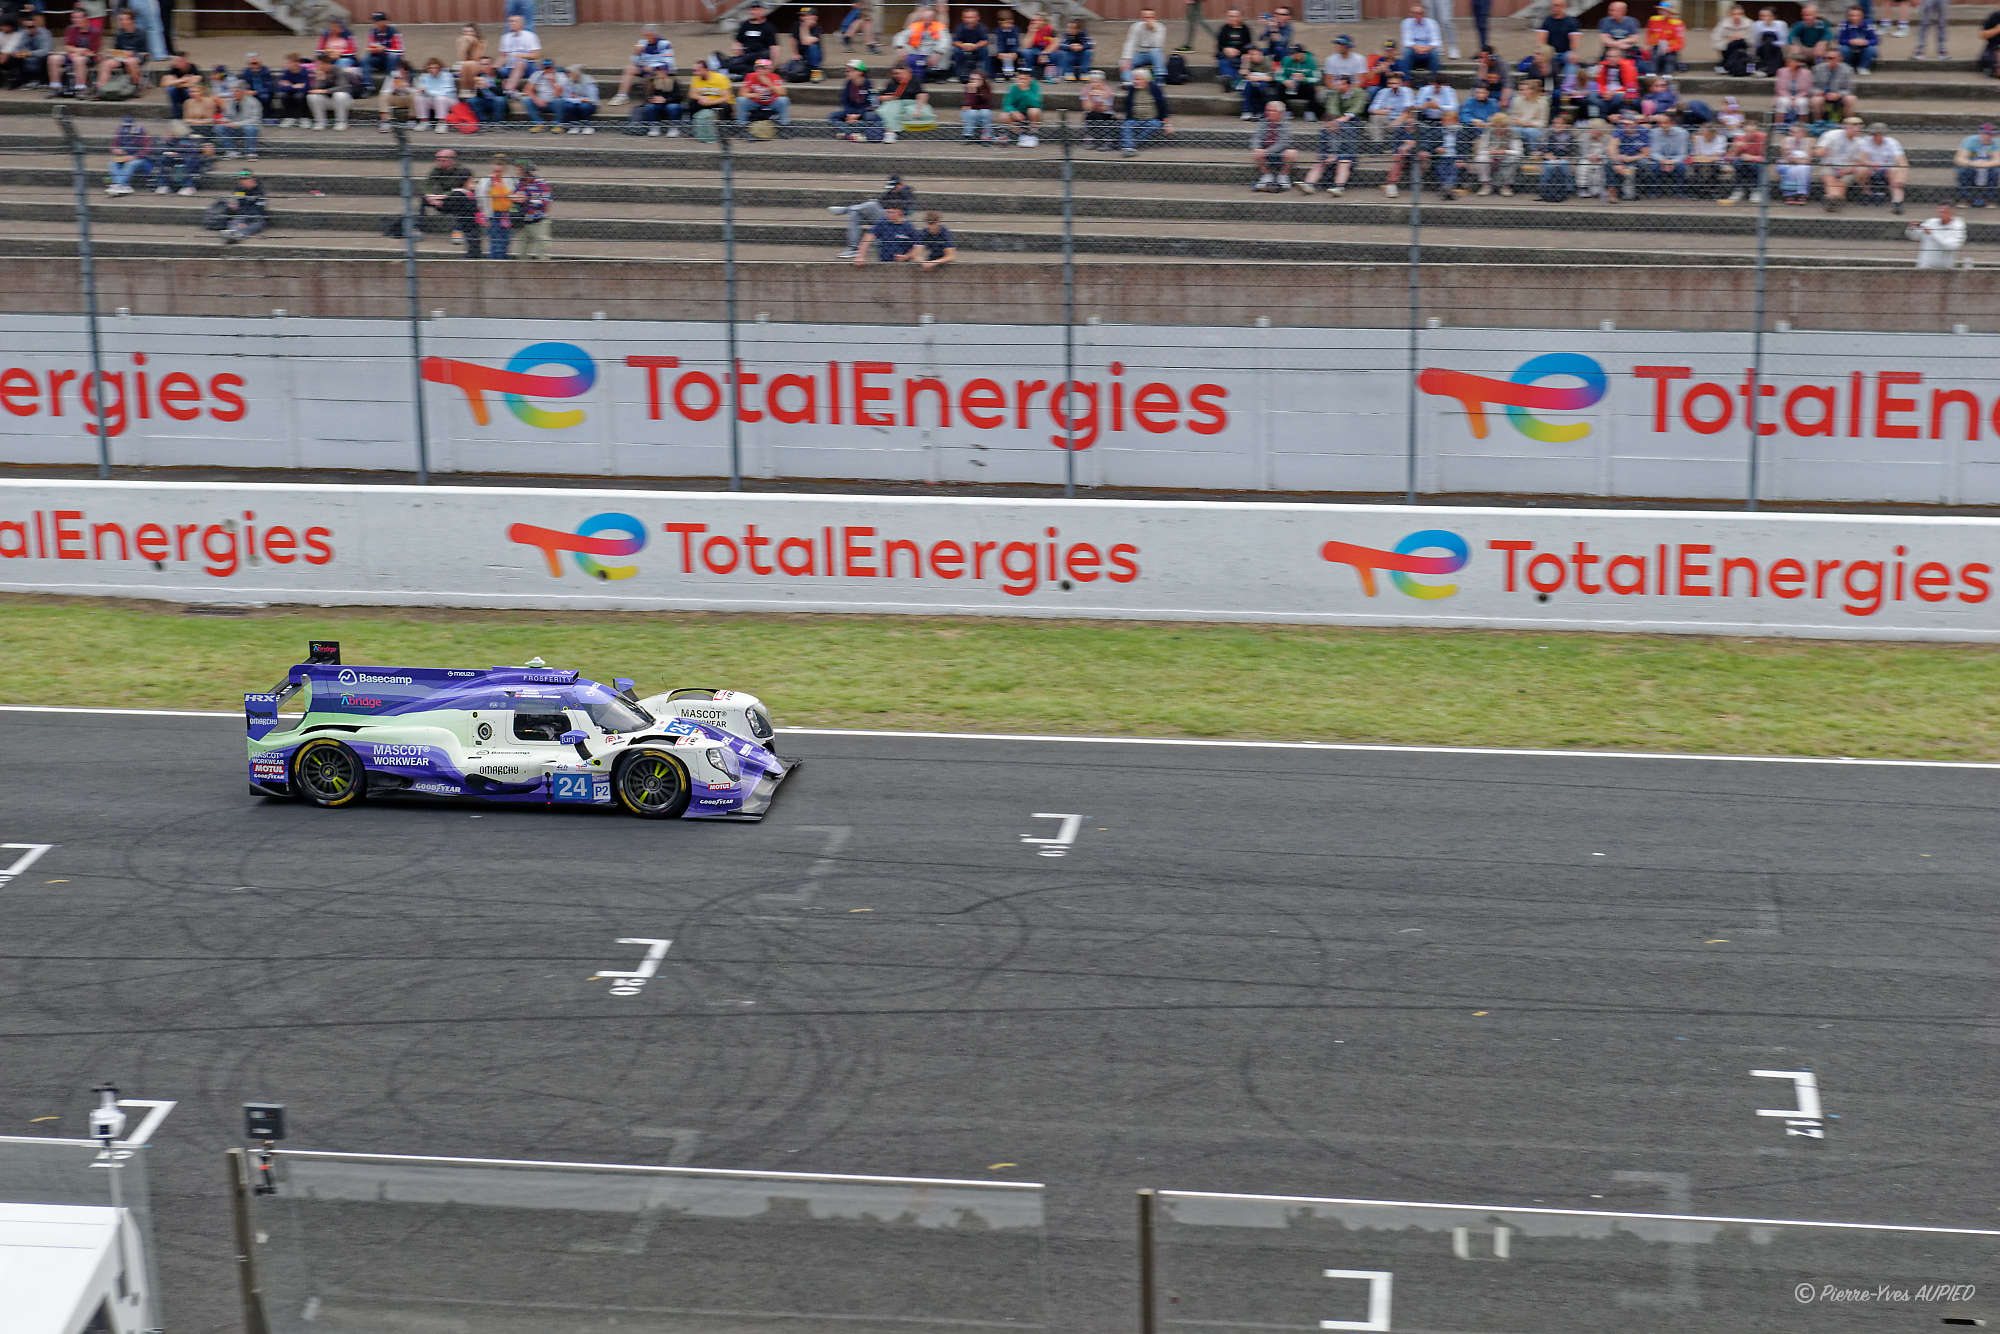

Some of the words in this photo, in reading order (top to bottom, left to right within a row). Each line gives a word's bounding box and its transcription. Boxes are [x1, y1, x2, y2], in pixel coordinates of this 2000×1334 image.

[0, 353, 246, 437] ergies
[625, 355, 1228, 451] TotalEnergies
[1633, 365, 2000, 441] TotalEn
[664, 522, 1140, 597] TotalEnergies
[1488, 539, 1991, 617] TotalEnergies
[359, 673, 412, 685] Basecamp
[341, 695, 382, 708] Abridge
[374, 756, 429, 766] WORKWEAR
[255, 765, 284, 773] MOTUL
[415, 782, 461, 793] GOODYEAR
[558, 777, 588, 797] 24
[595, 785, 609, 797] P2
[699, 798, 734, 806] GOODYEAR
